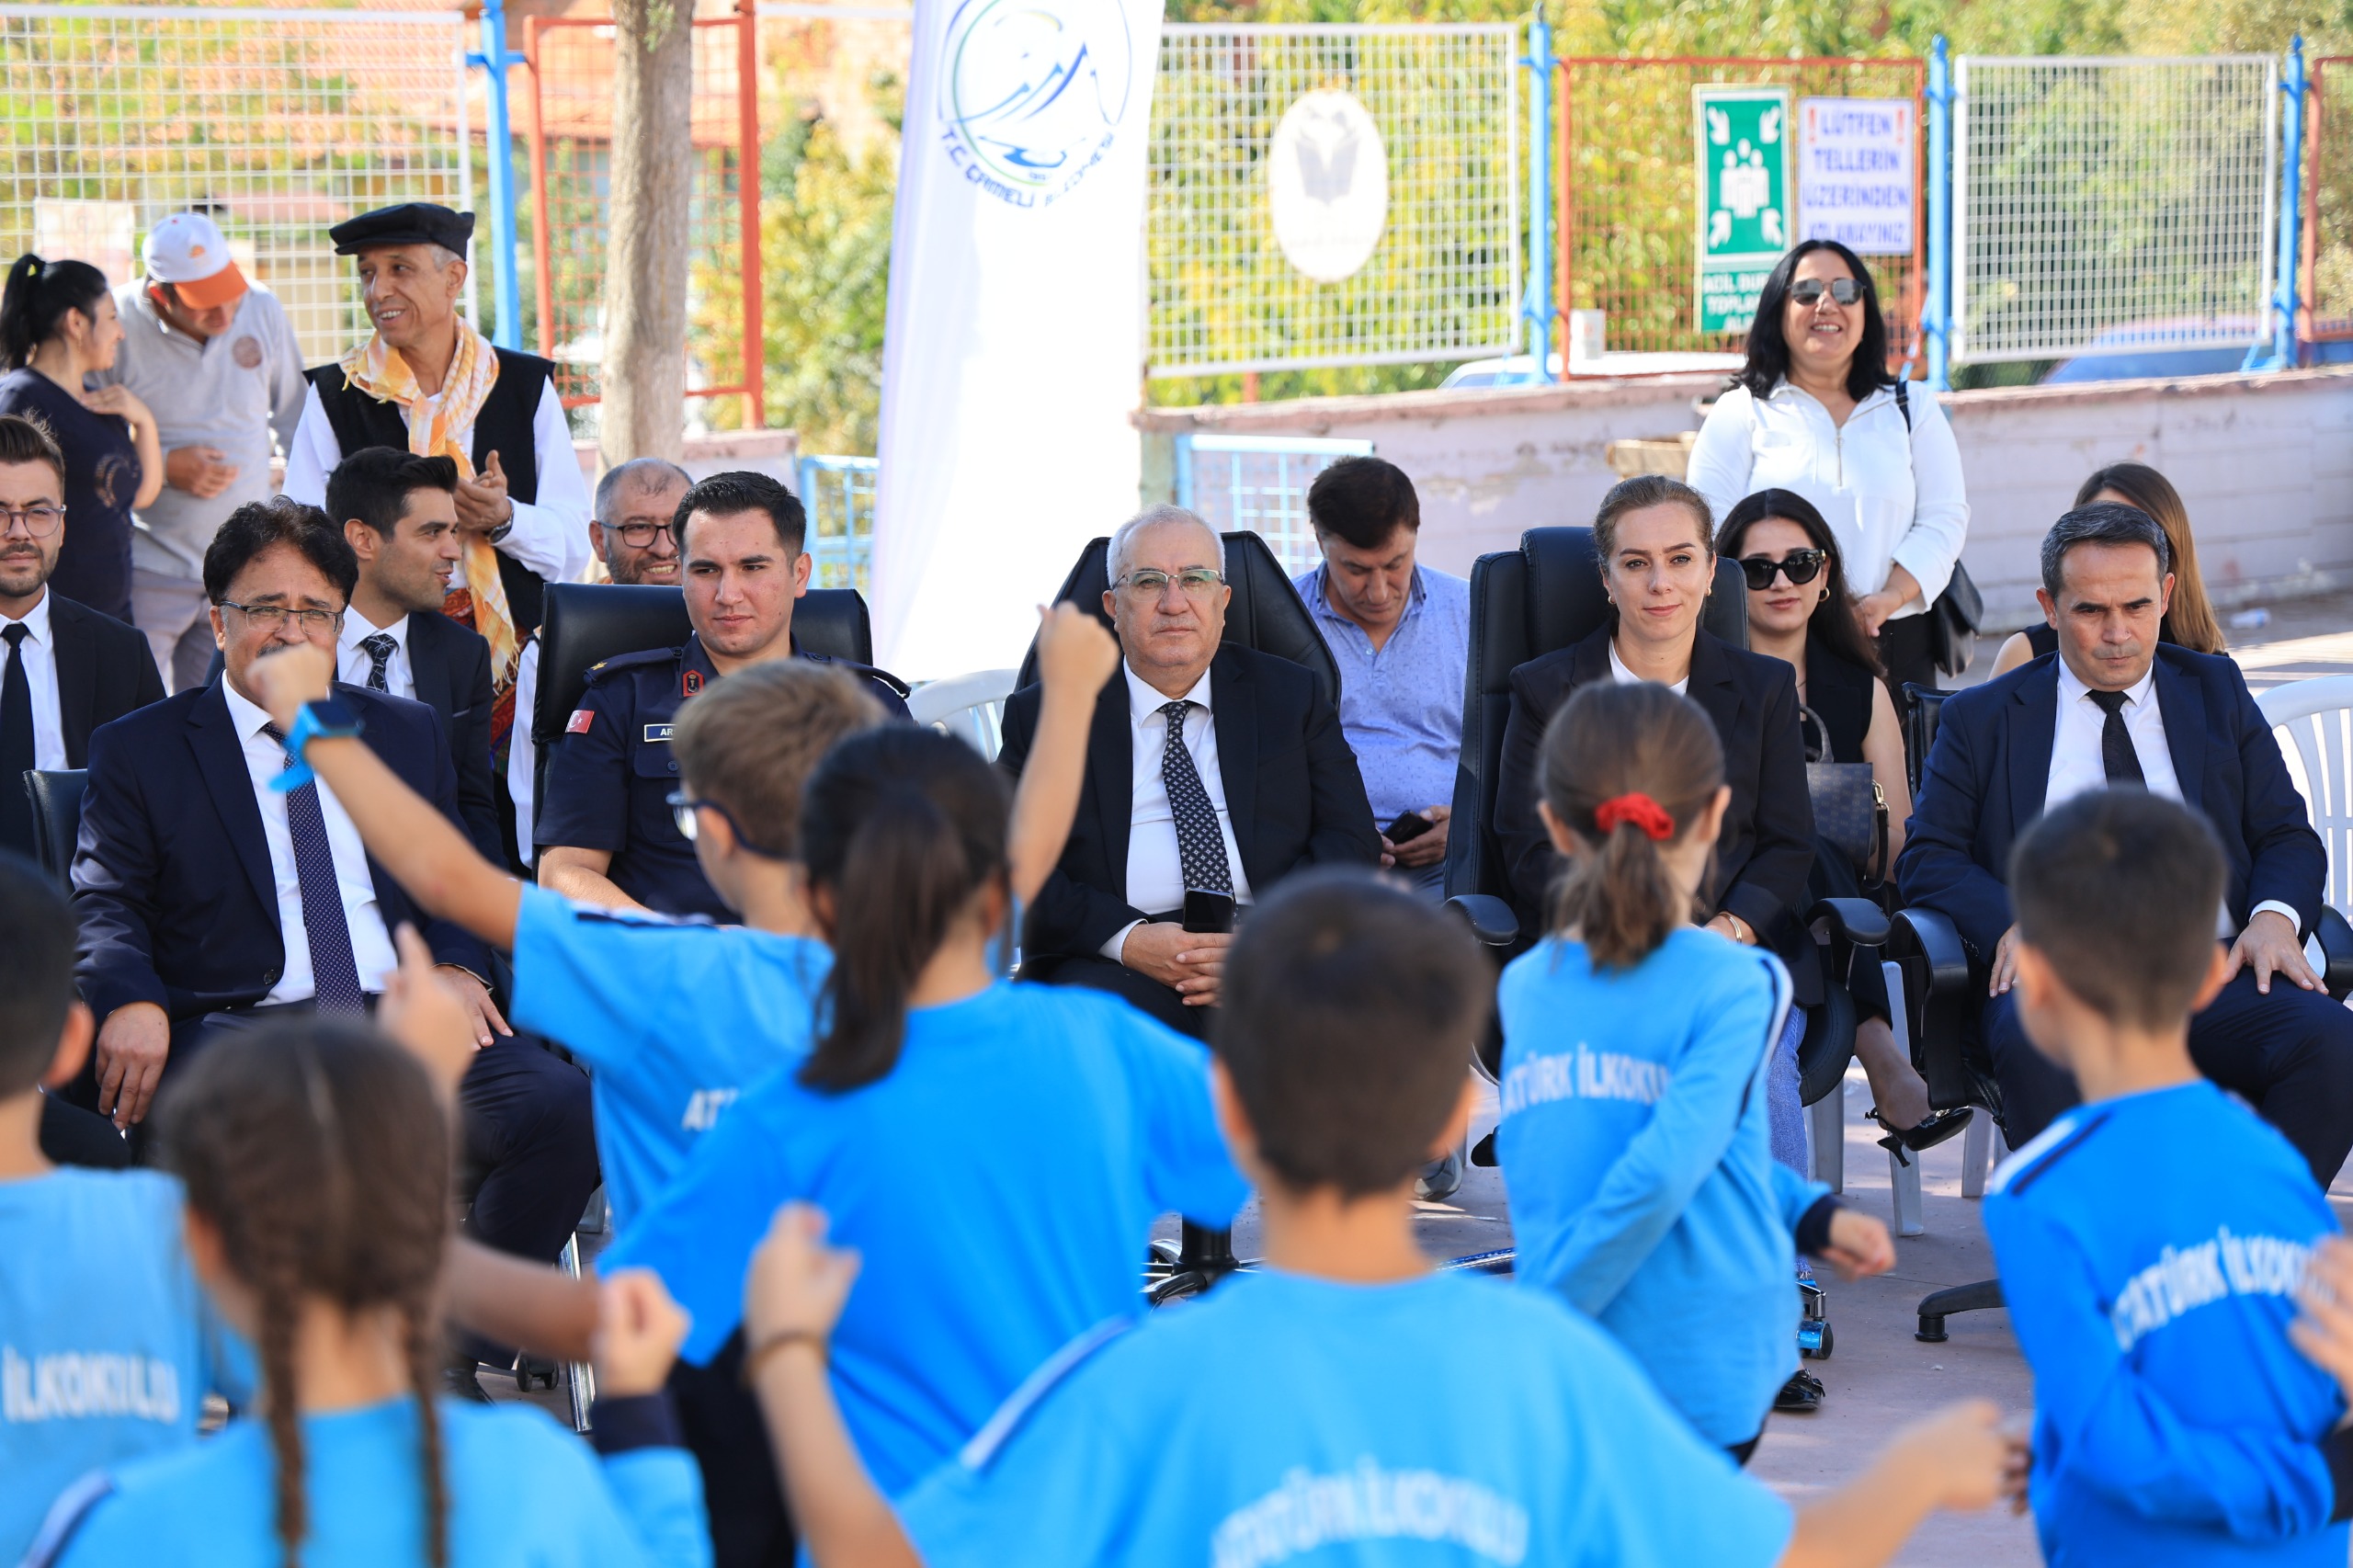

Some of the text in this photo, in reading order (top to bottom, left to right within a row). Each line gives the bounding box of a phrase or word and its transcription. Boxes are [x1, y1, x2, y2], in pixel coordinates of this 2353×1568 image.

[1821, 108, 1891, 136] LÜTFEN
[1814, 144, 1900, 172] TELLERİN
[1805, 179, 1908, 208] ÜZERİNDEN
[659, 727, 676, 736] AR
